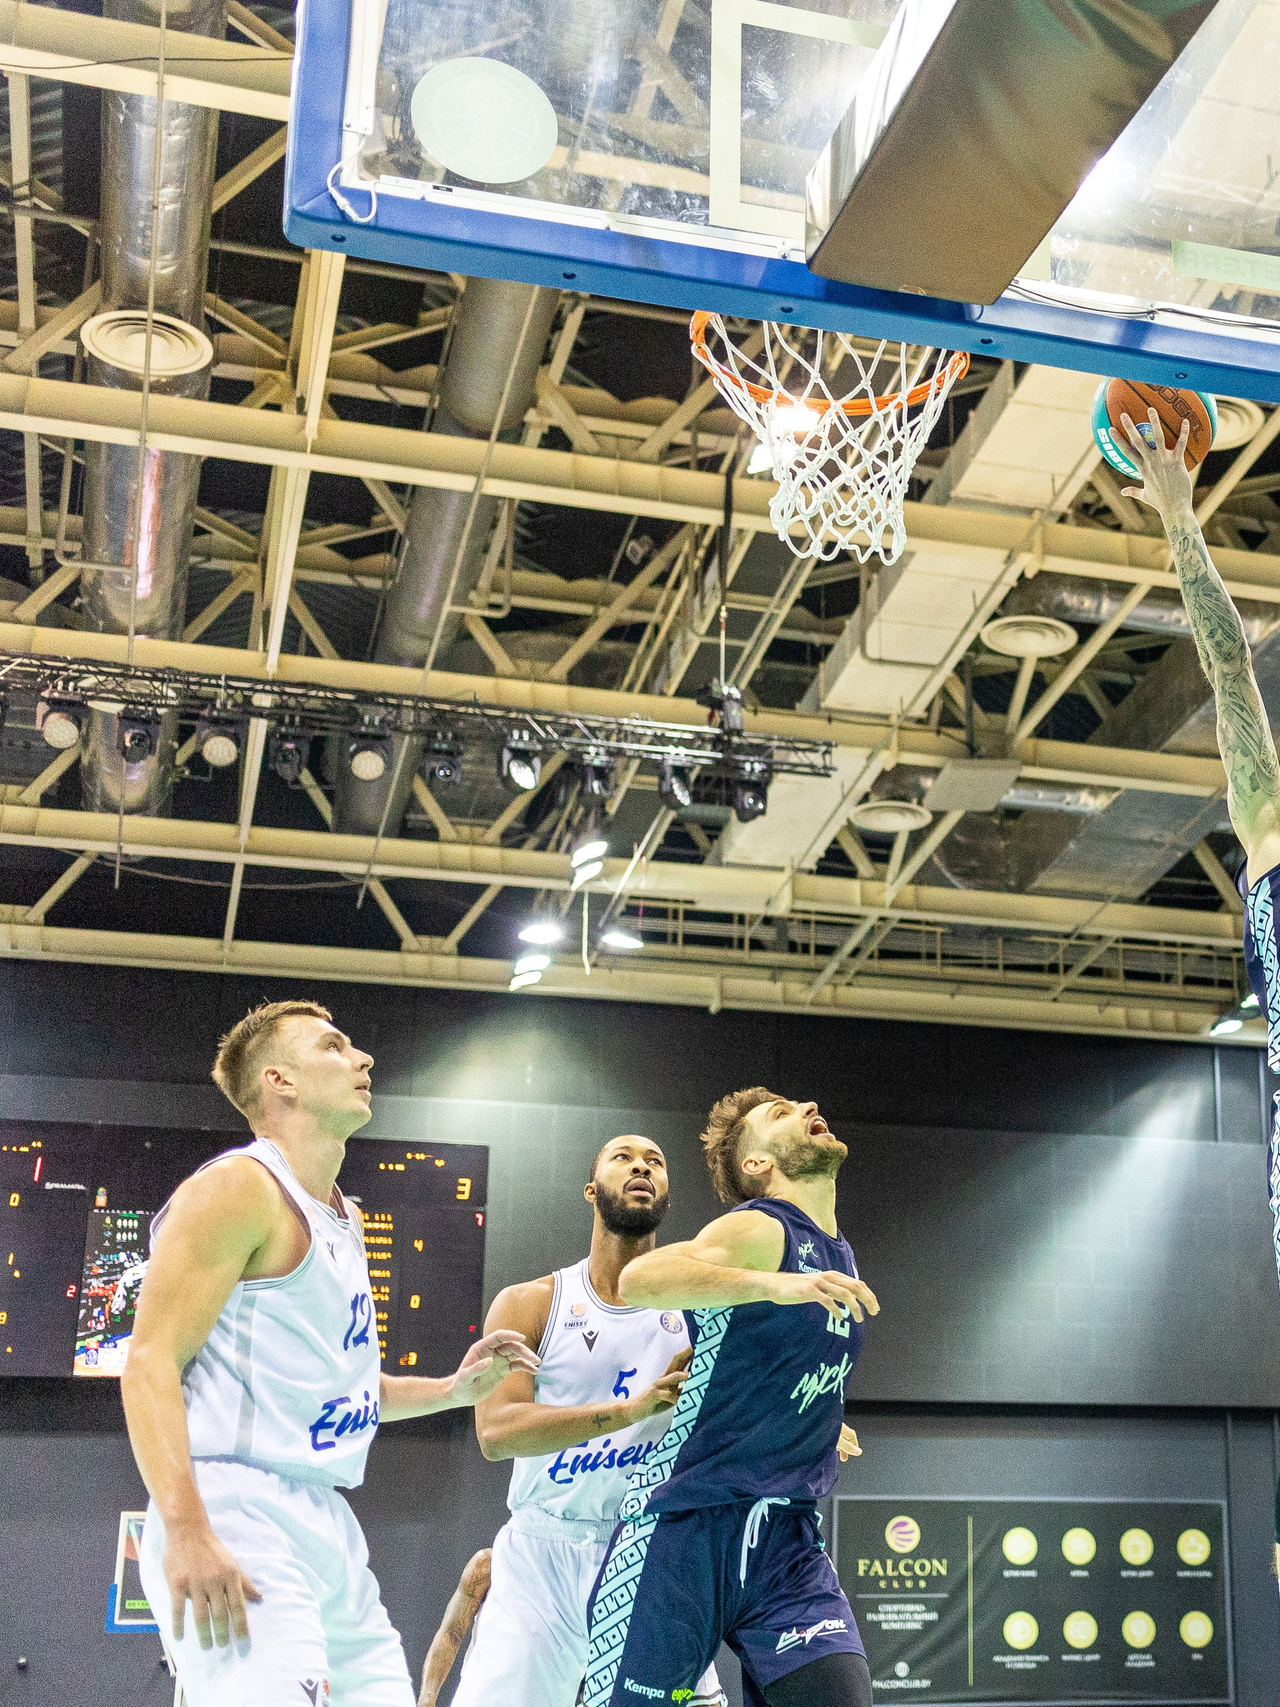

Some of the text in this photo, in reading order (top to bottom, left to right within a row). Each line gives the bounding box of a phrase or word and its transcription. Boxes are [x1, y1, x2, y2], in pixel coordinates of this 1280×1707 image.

[455, 1177, 472, 1200] 3
[66, 1283, 77, 1298] 2
[409, 1294, 421, 1309] 0
[343, 1292, 371, 1351] 12
[564, 1319, 588, 1328] ENISEY
[612, 1367, 637, 1400] 5
[309, 1390, 379, 1452] Enis
[857, 1557, 948, 1578] FALCON
[879, 1579, 927, 1589] CLUB
[623, 1677, 665, 1700] Kempa
